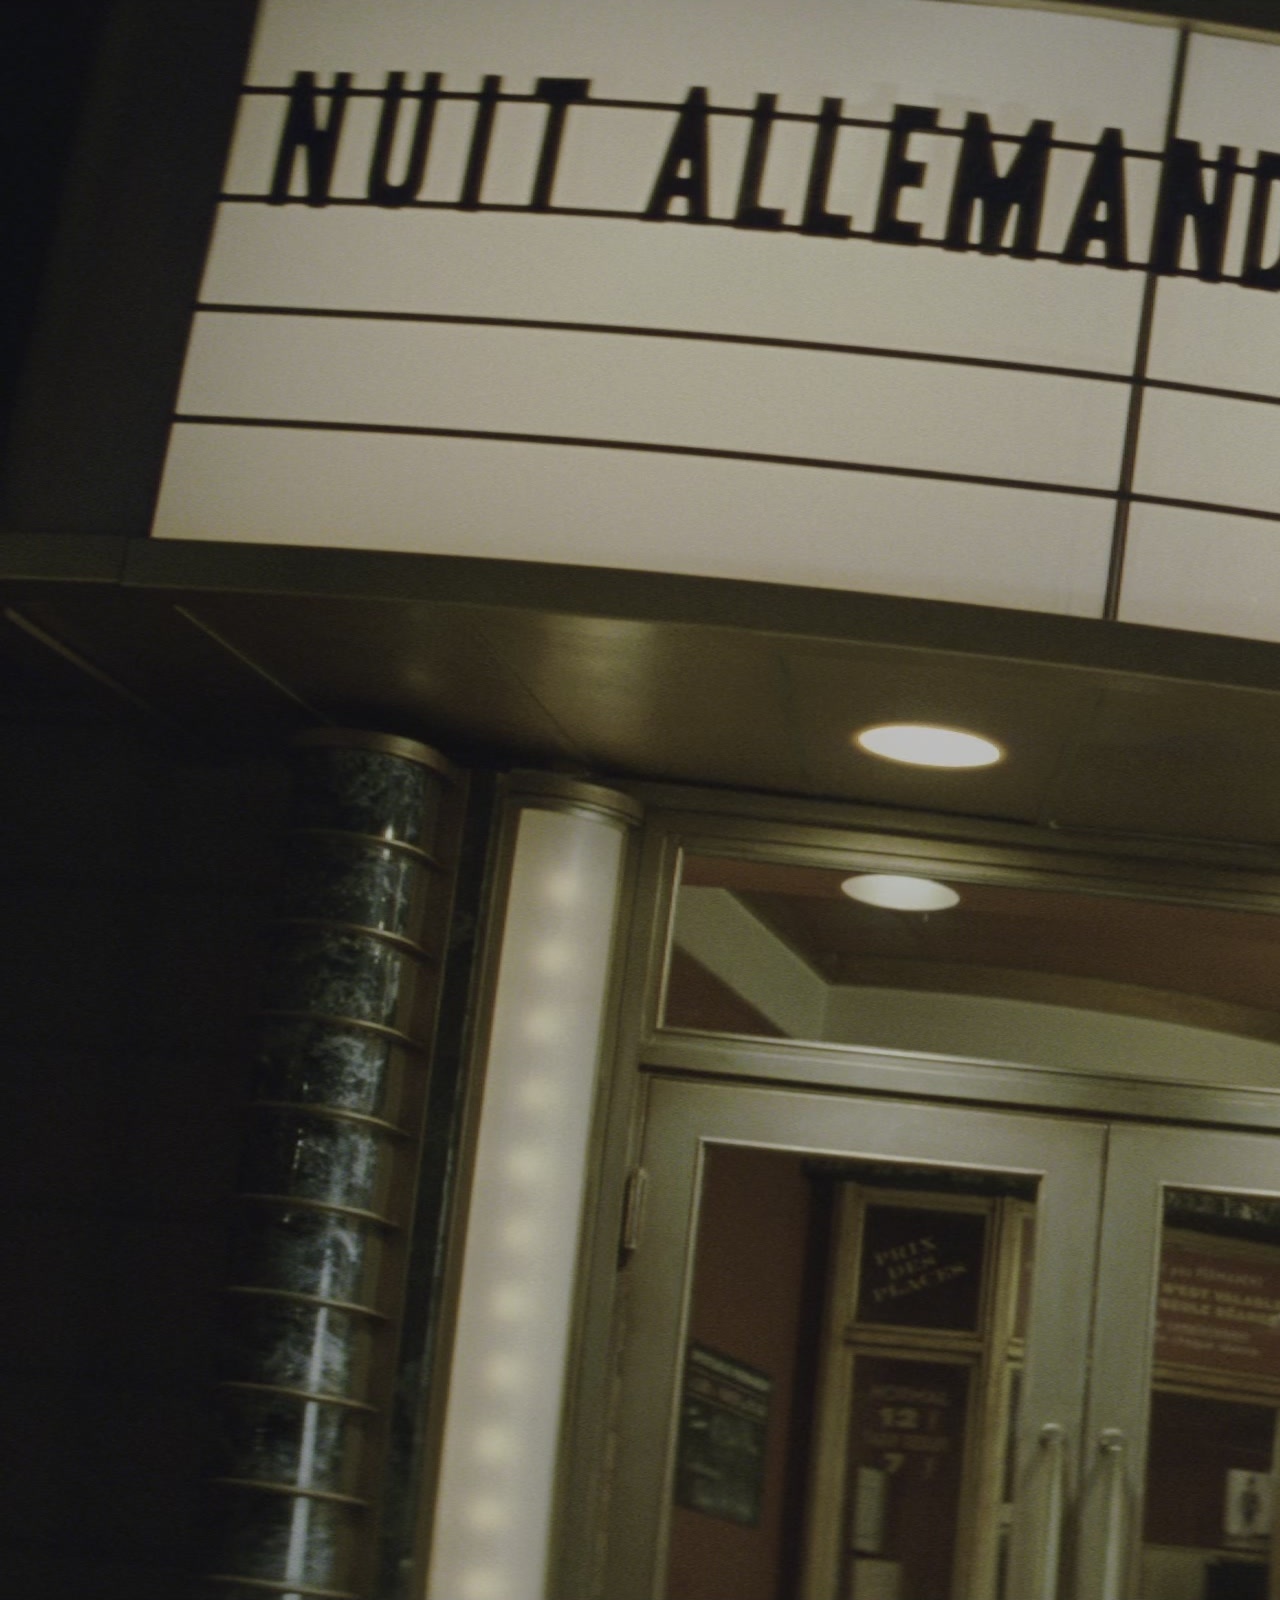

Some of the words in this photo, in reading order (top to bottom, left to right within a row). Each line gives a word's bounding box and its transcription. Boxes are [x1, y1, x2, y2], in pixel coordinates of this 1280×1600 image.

[271, 70, 591, 211] NUIT
[874, 1236, 936, 1266] PRIX
[886, 1255, 936, 1280] DES
[872, 1264, 967, 1302] PLACES
[879, 1407, 918, 1428] 12
[884, 1453, 904, 1473] 7
